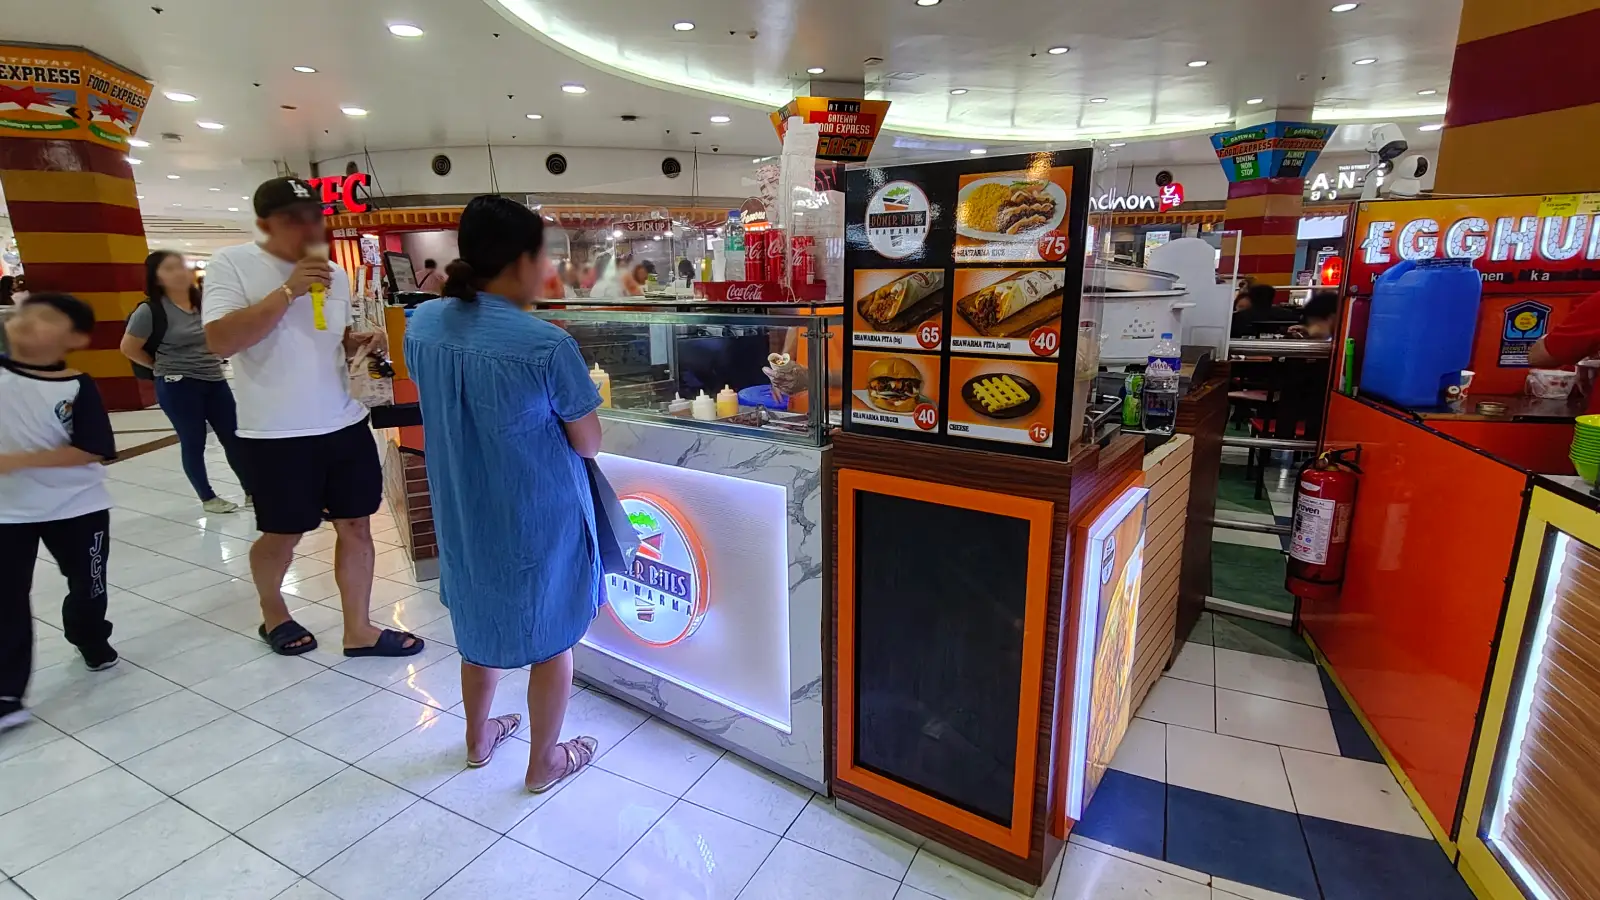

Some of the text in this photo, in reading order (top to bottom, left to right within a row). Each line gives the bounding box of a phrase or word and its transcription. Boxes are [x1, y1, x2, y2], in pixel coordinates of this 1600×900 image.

[86, 74, 147, 109] FOOD EXPRESS
[844, 104, 860, 112] THE
[828, 113, 858, 124] GATEWAY
[817, 122, 870, 135] OOD EXPRESS
[1230, 133, 1256, 143] GATEWAY
[1239, 140, 1273, 155] EXPRESS
[1235, 154, 1255, 164] DINING
[1240, 169, 1254, 177] STOP
[308, 172, 371, 214] FC
[1089, 187, 1156, 210] nchon
[655, 222, 665, 231] UP
[1044, 236, 1066, 255] 75
[854, 334, 880, 342] SHAWARMA
[881, 335, 893, 343] PITA
[921, 326, 939, 343] 65
[1035, 331, 1057, 351] 40
[952, 339, 982, 348] SHAWARMA
[983, 341, 995, 349] PITA
[853, 411, 899, 424] SHAWARMA BURGER
[918, 408, 935, 425] 40
[949, 423, 969, 433] CHEESE
[1034, 426, 1047, 440] 15
[611, 575, 692, 617] HAWARMA
